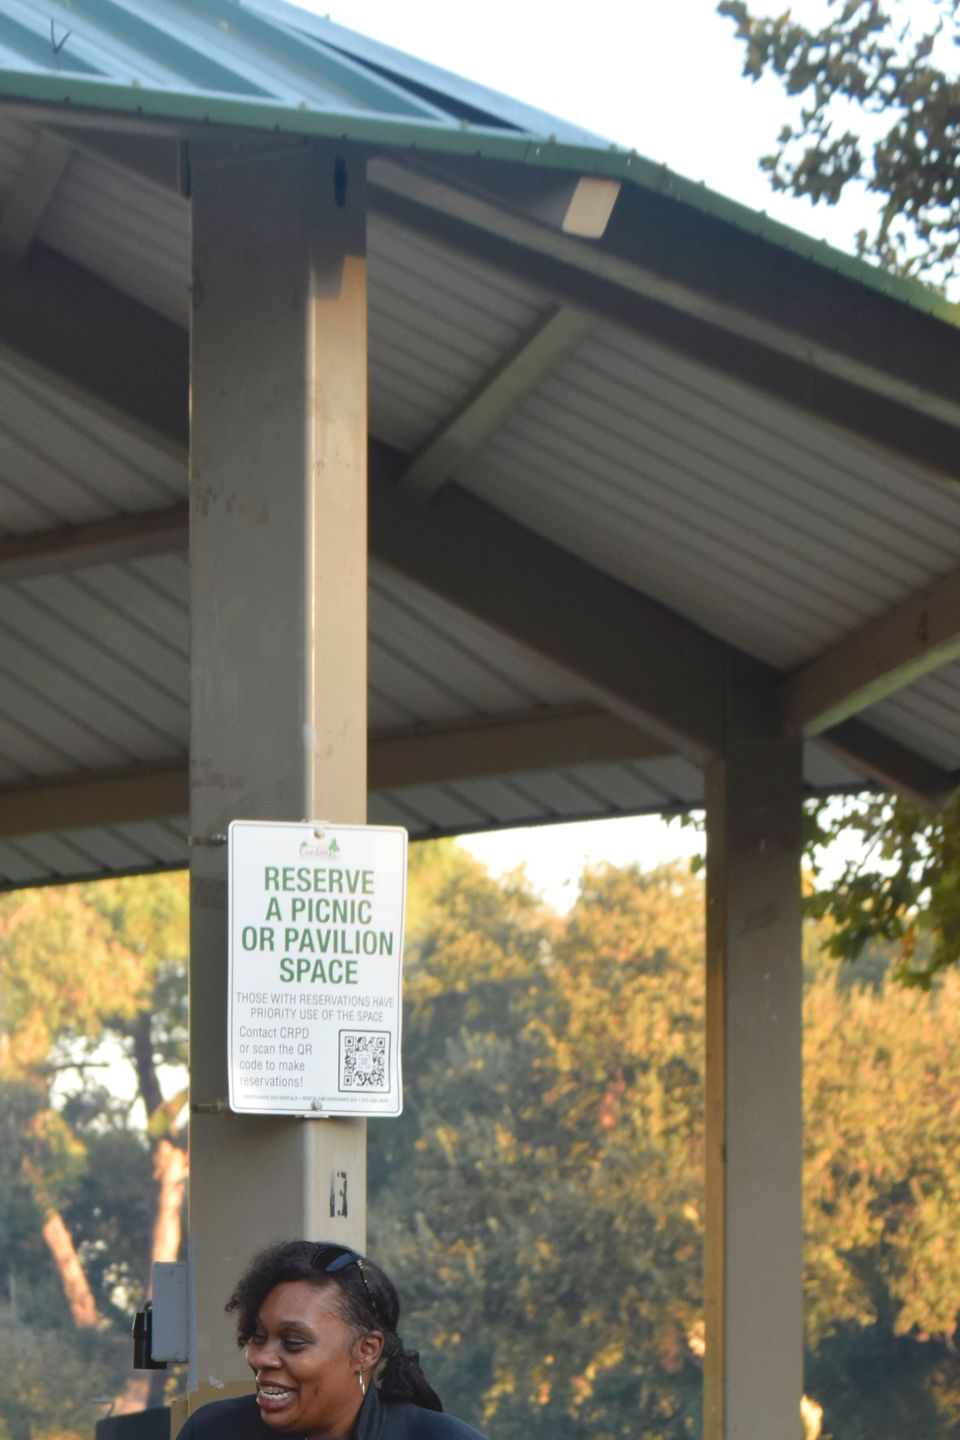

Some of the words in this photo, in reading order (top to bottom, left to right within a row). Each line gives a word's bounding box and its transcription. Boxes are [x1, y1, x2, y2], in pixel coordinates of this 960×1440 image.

[265, 867, 374, 894] RESERVE
[266, 897, 282, 921] A
[292, 898, 371, 924] PICNIC
[242, 926, 274, 951] OR
[285, 928, 393, 955] PAVILION
[280, 958, 357, 984] SPACE
[236, 992, 267, 1004] THOSE
[271, 993, 296, 1004] WITH
[300, 994, 369, 1007] RESERVATIONS
[373, 997, 394, 1008] HAVE
[251, 1008, 296, 1018] PRIORITY
[300, 1009, 318, 1020] USE
[322, 1009, 334, 1020] OF
[337, 1010, 354, 1021] THE
[357, 1011, 383, 1022] SPACE
[240, 1026, 276, 1038] Contact
[280, 1027, 309, 1039] CRPD
[240, 1044, 249, 1053] or
[253, 1045, 277, 1054] scan
[280, 1044, 294, 1055] the
[298, 1044, 312, 1055] QR
[240, 1059, 262, 1070] code
[266, 1060, 275, 1070] to
[279, 1061, 304, 1071] make
[240, 1076, 303, 1087] reservations!
